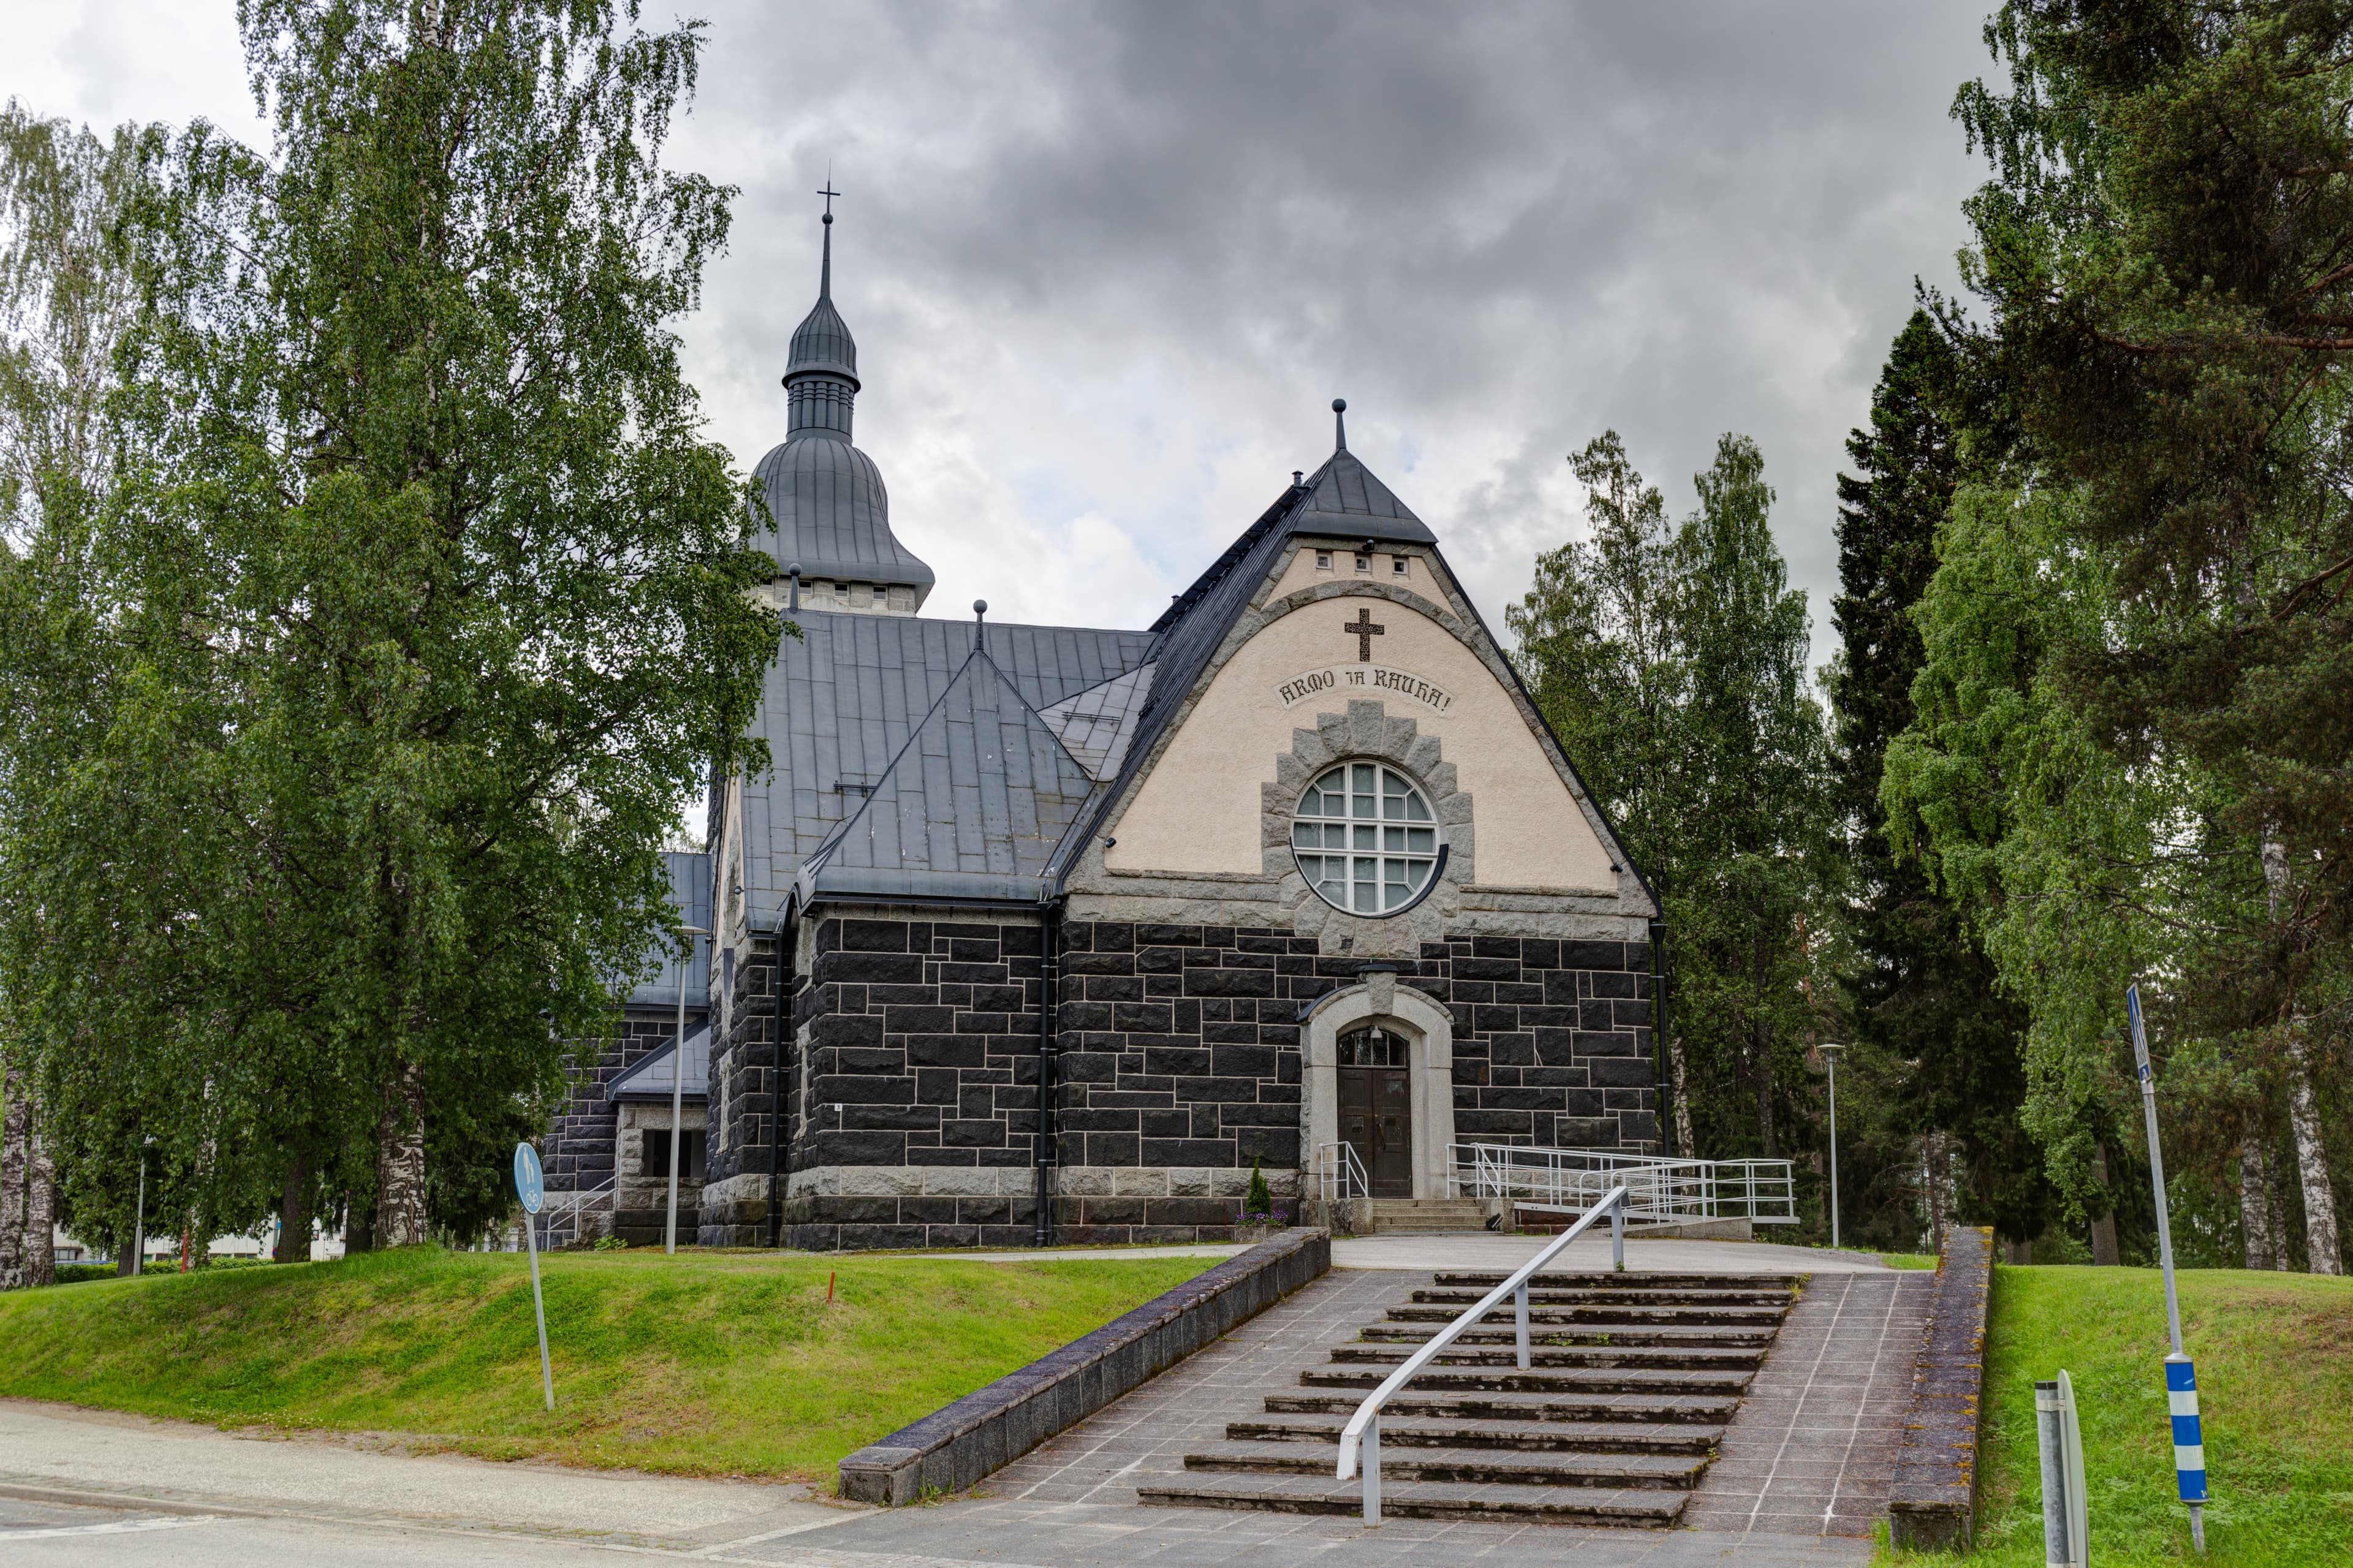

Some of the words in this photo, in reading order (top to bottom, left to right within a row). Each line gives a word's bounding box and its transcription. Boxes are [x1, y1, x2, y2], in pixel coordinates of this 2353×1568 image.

[1279, 670, 1335, 705] ARMO
[1346, 671, 1365, 685] JA
[1373, 668, 1451, 711] RAUHA!
